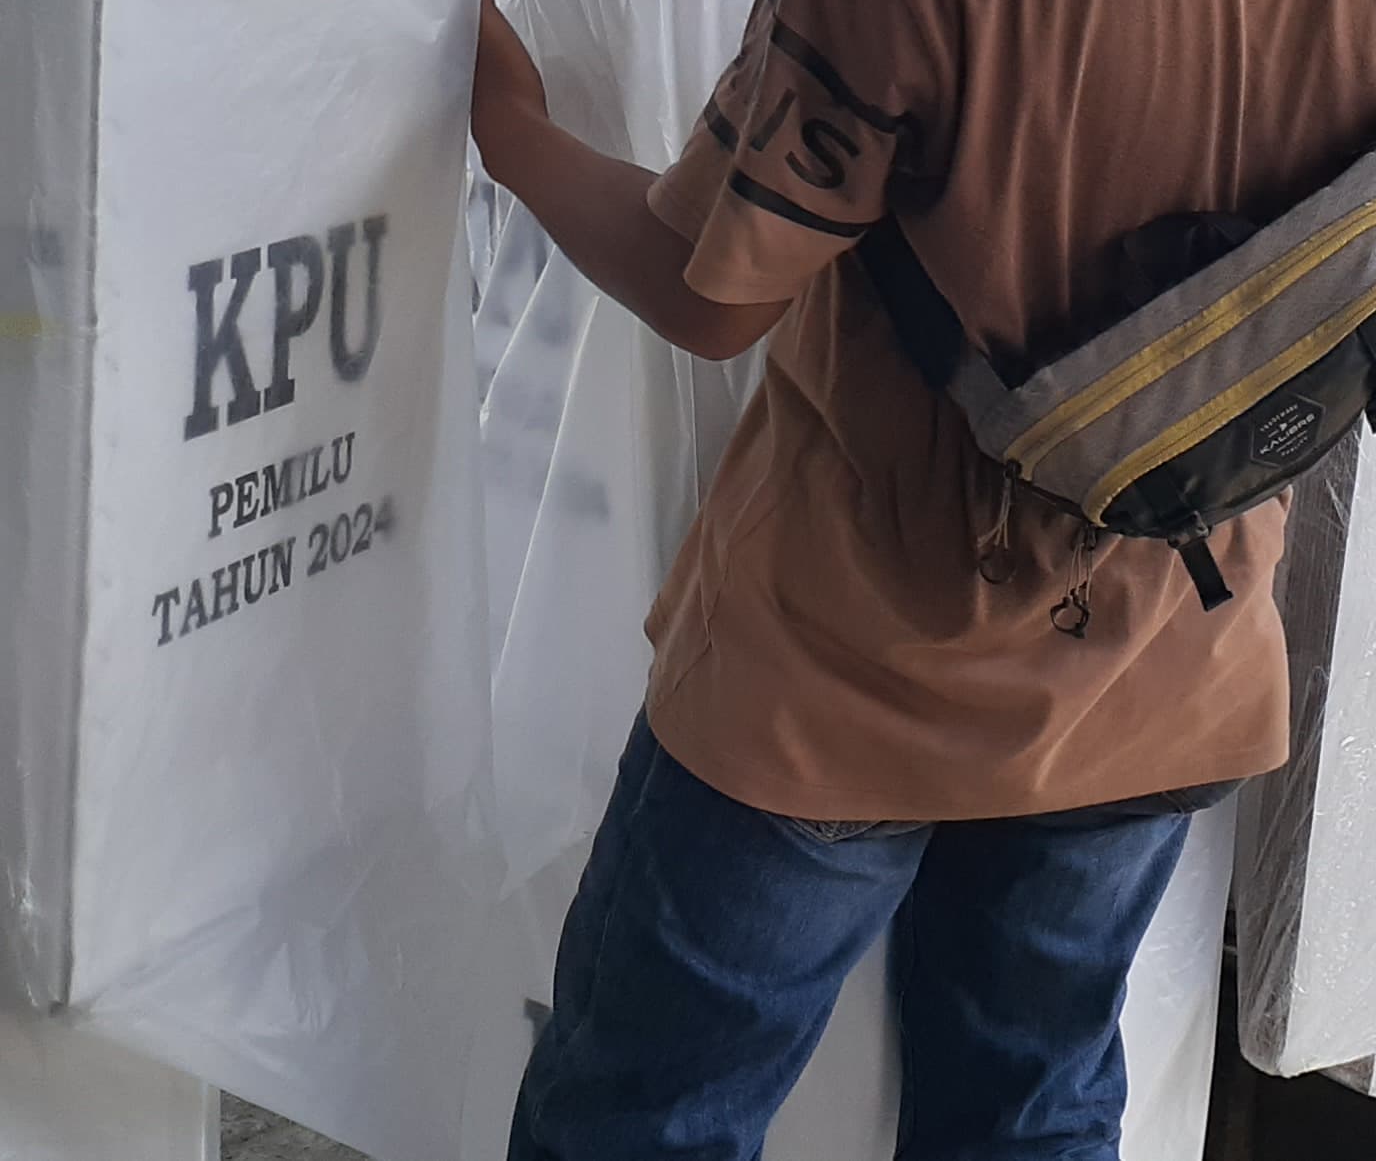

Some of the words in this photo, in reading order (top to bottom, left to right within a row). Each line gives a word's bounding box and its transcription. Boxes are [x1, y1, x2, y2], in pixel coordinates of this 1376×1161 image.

[183, 212, 389, 442] KPU
[207, 431, 356, 539] PEMILU
[152, 537, 297, 647] TAHUN
[307, 494, 399, 577] 2024
